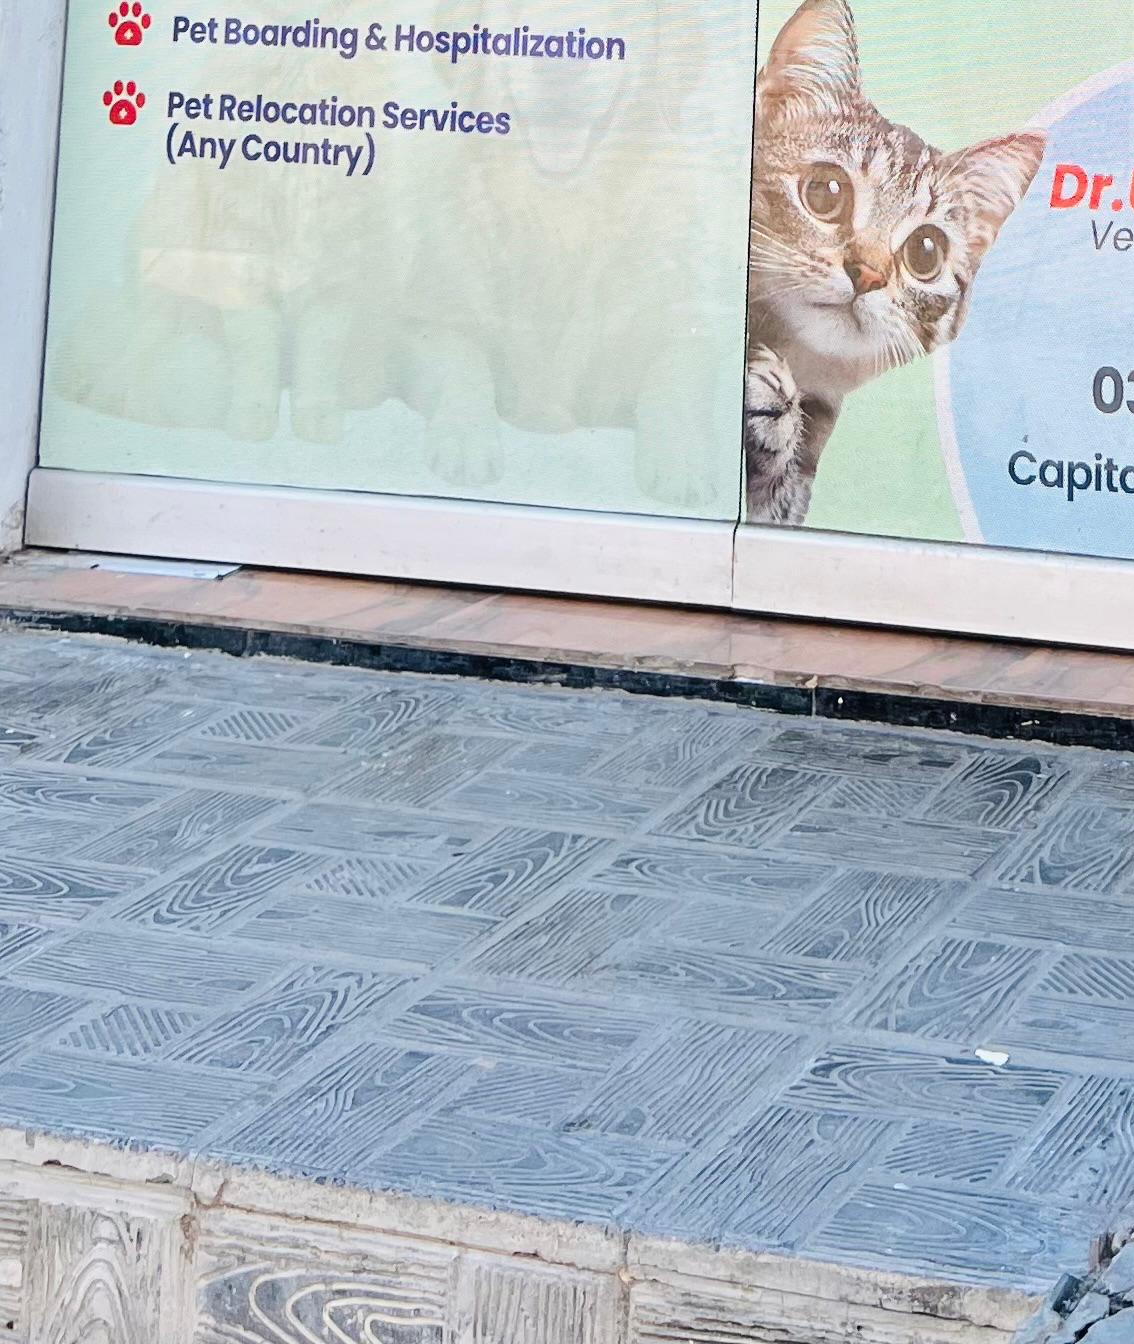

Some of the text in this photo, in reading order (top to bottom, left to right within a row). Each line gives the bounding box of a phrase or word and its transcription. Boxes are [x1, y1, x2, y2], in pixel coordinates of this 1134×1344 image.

[172, 15, 626, 63] Pet Boarding & Hospitalization
[168, 92, 511, 135] Pet Relocation Services
[166, 123, 376, 177] (Any Country)
